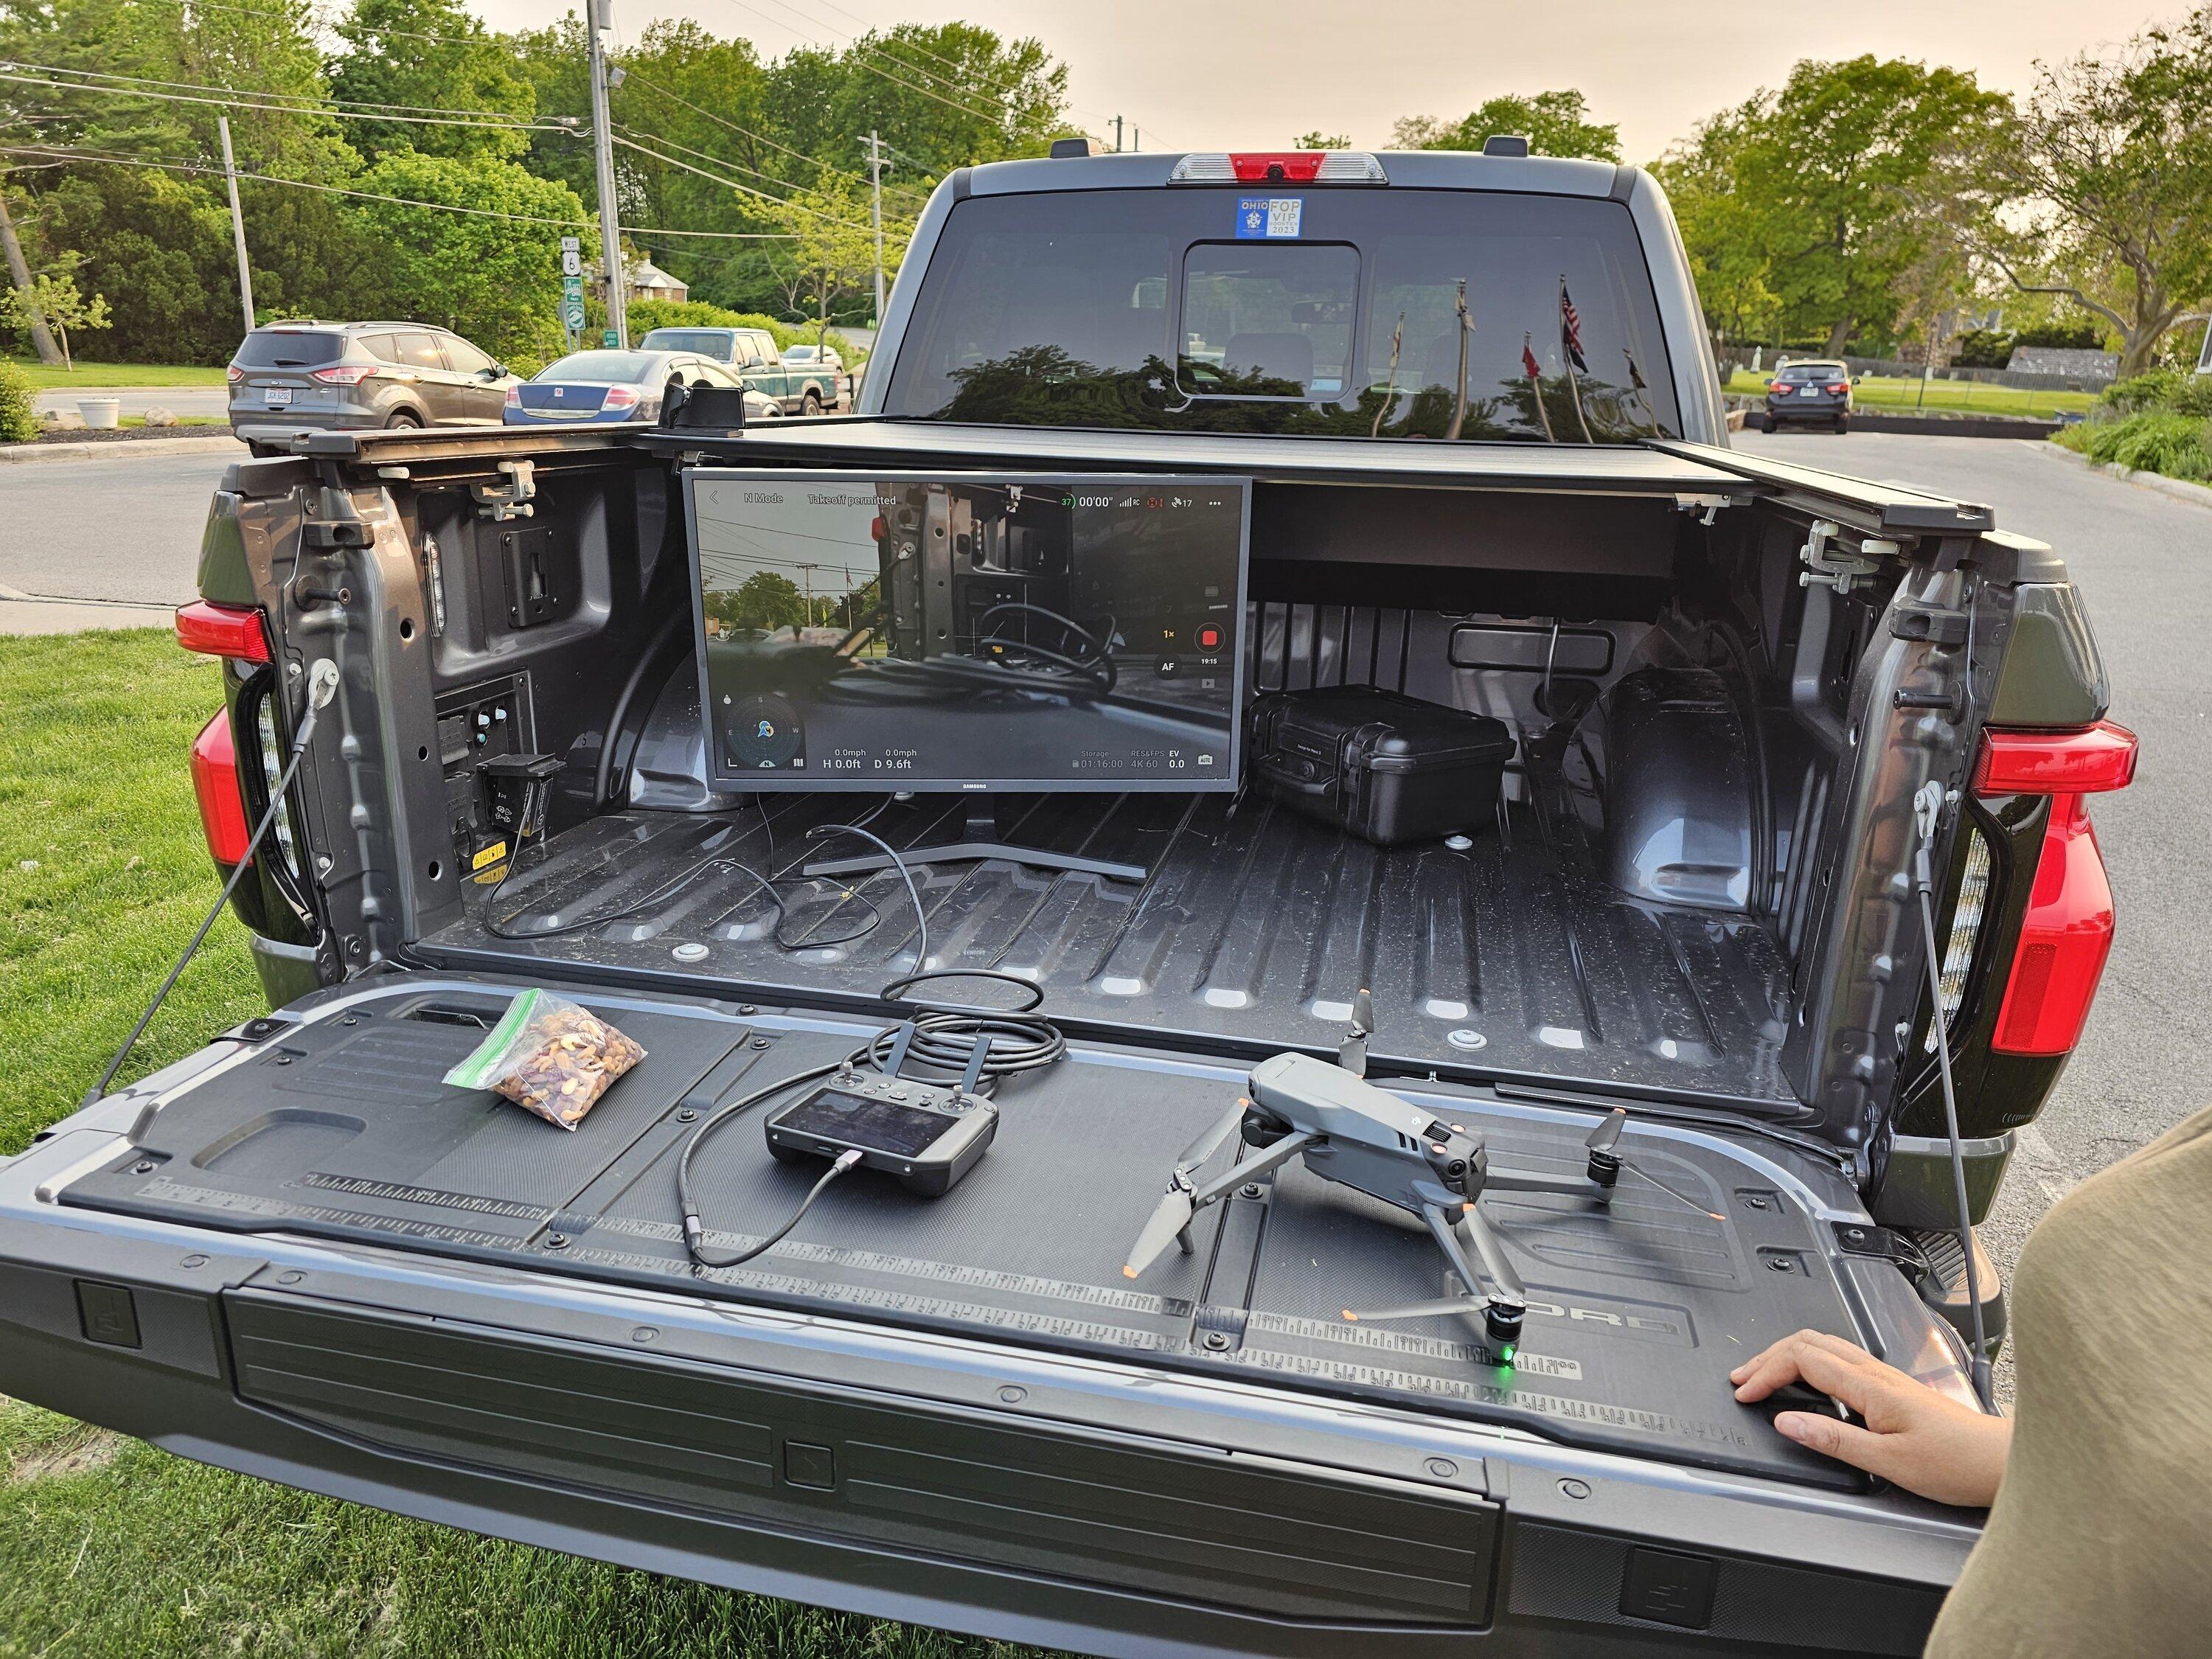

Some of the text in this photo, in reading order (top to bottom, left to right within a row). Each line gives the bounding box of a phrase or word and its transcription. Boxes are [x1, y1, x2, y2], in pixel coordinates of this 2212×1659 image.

[1270, 201, 1300, 212] FOP
[1273, 213, 1296, 221] VIP
[565, 240, 577, 248] WEST
[569, 257, 575, 270] 6
[744, 493, 784, 504] N Mode
[807, 494, 897, 507] Takeoff permitted
[1132, 498, 1141, 507] RC
[1183, 499, 1193, 507] 17
[1161, 662, 1175, 672] AF
[835, 748, 917, 758] 0.0mph 0.0mph
[1081, 750, 1110, 758] Storage
[823, 759, 911, 769] H 0.0ft D 9.6ft
[1081, 759, 1123, 768] 01:16:00
[1130, 759, 1158, 768] 4K 60
[1169, 759, 1185, 768] 0.0
[1526, 1301, 1683, 1335] ORD
